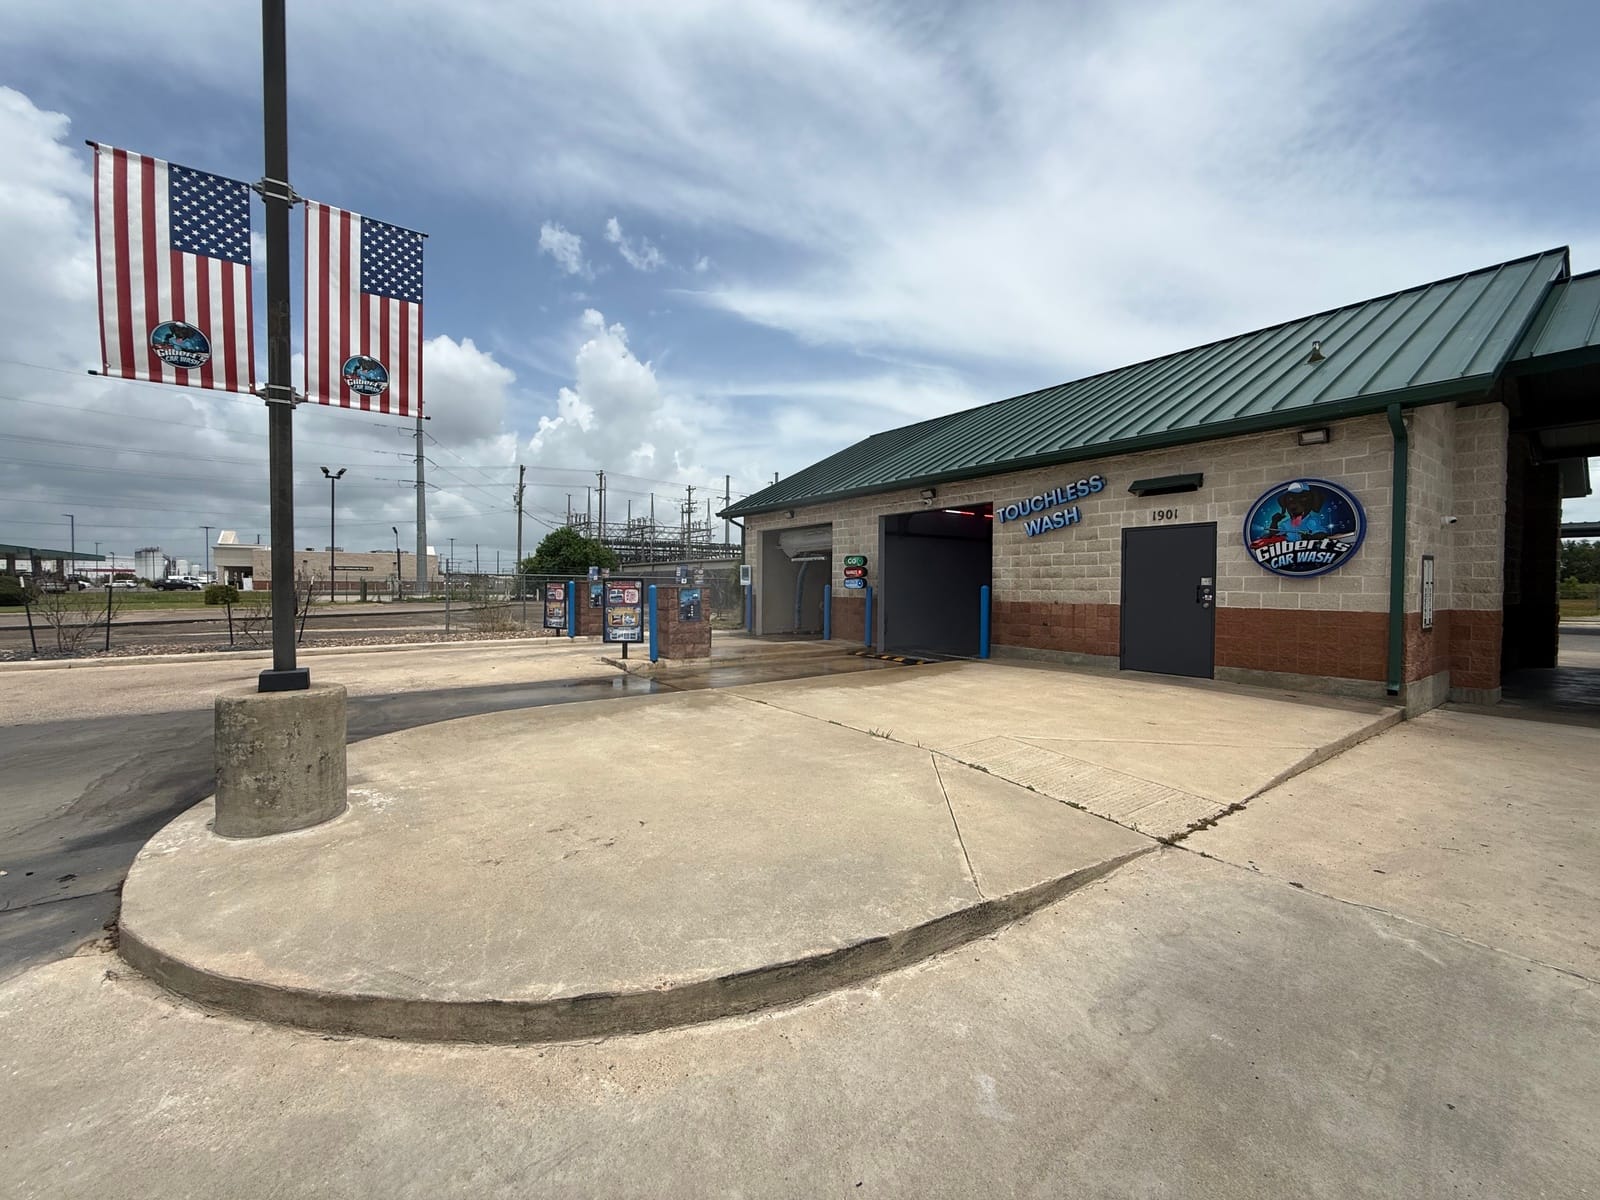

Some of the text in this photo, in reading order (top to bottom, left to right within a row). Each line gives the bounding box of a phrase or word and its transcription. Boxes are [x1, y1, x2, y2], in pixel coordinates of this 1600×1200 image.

[996, 474, 1105, 524] TOUCHLESS
[1023, 506, 1082, 537] WASH
[1152, 508, 1178, 521] 1901
[1255, 538, 1352, 562] Gilbert's
[1270, 550, 1336, 569] CAR WASH
